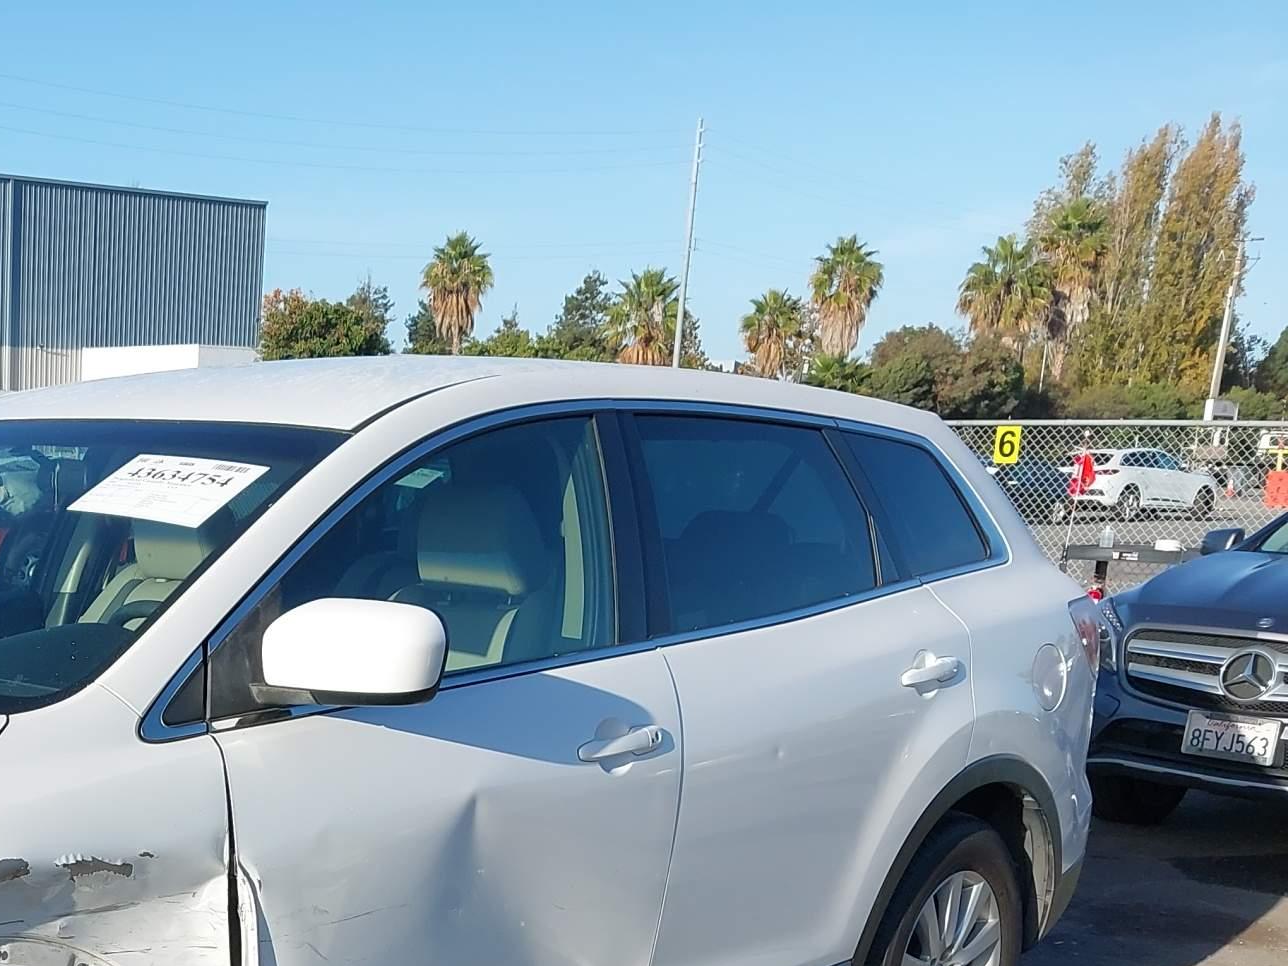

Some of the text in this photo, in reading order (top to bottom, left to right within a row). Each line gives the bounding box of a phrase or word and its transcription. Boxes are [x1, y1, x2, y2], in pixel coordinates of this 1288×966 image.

[999, 430, 1016, 458] 6
[128, 466, 234, 488] 43634754
[1190, 728, 1269, 757] 8FYJ563
